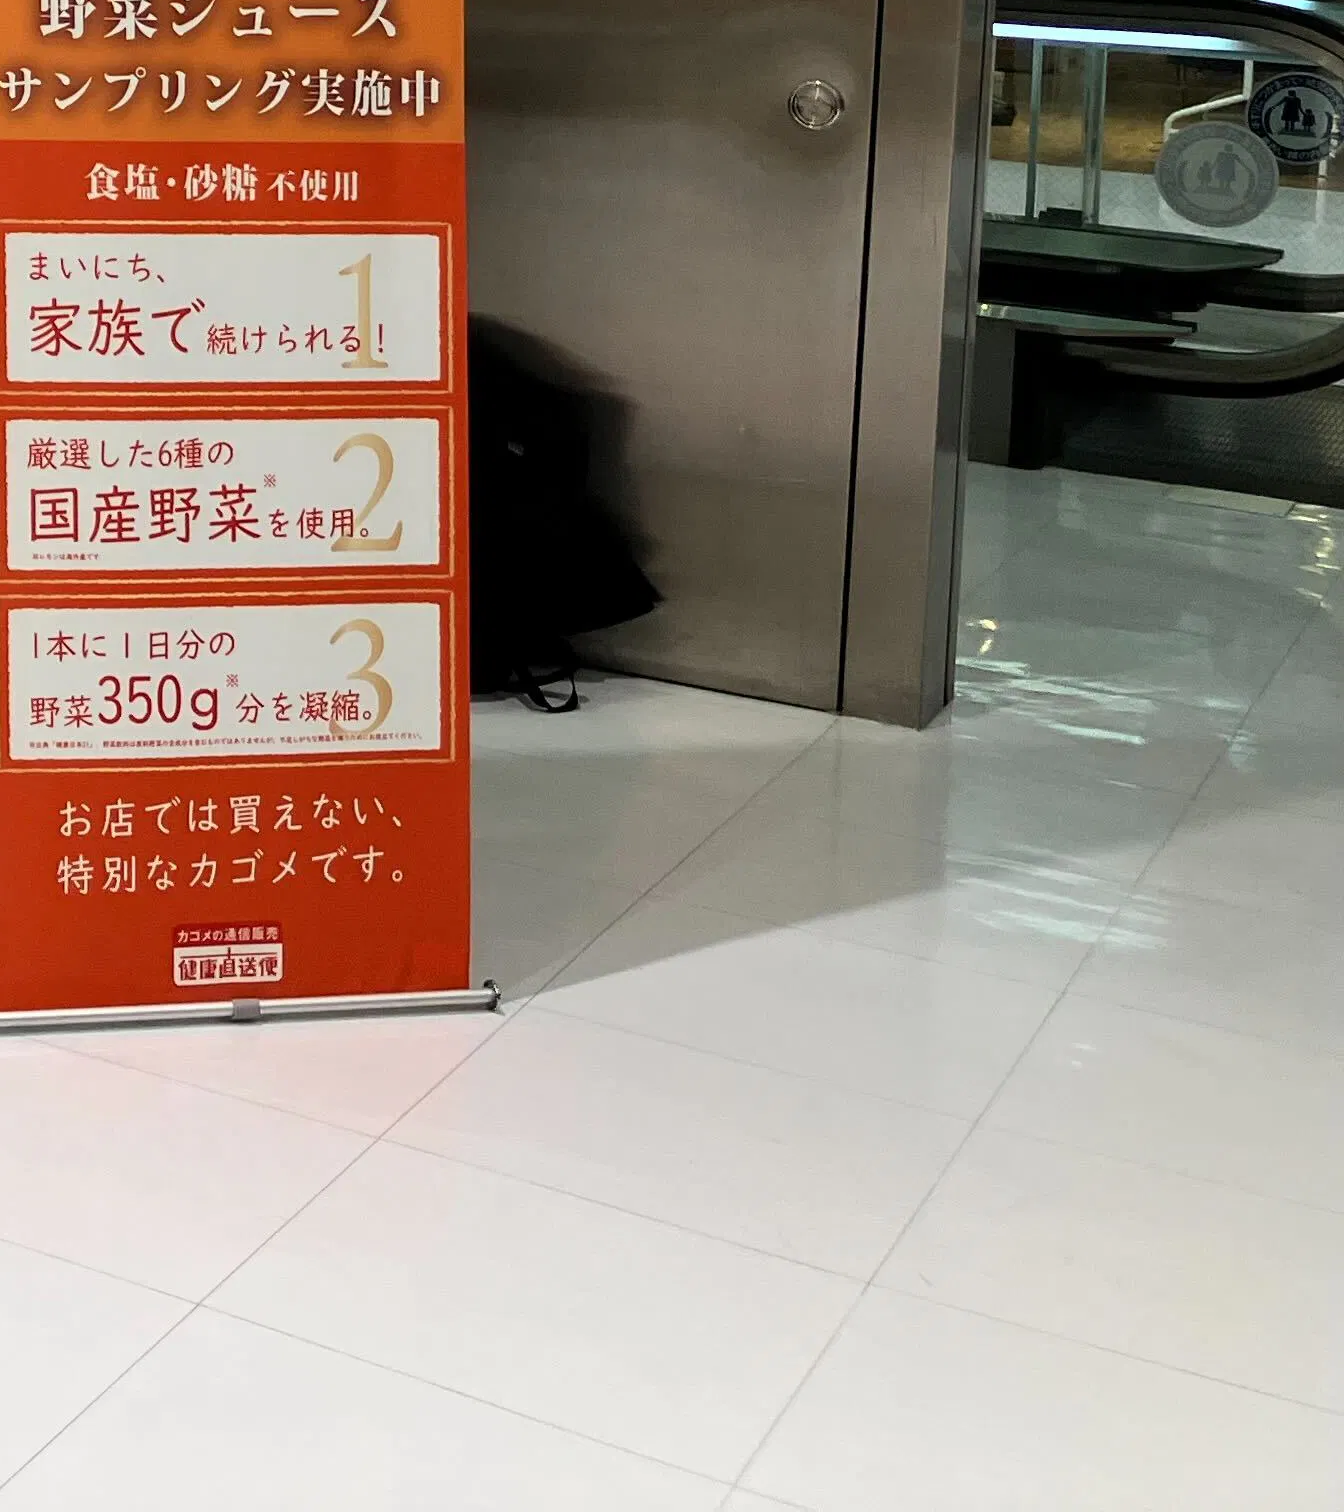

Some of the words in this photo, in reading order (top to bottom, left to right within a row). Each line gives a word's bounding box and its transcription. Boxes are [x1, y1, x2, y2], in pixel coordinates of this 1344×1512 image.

[27, 251, 167, 284] まいにち、
[338, 252, 389, 370] 1
[26, 436, 235, 471] 厳選した6種の
[330, 432, 404, 553] 2
[32, 629, 236, 661] 1本に1日分の
[328, 618, 393, 736] 3
[58, 793, 402, 838] お店では買えない、
[56, 846, 404, 895] 特別なカゴメです。
[177, 925, 280, 944] カゴメの通信販売
[178, 950, 279, 981] 健康直送便
